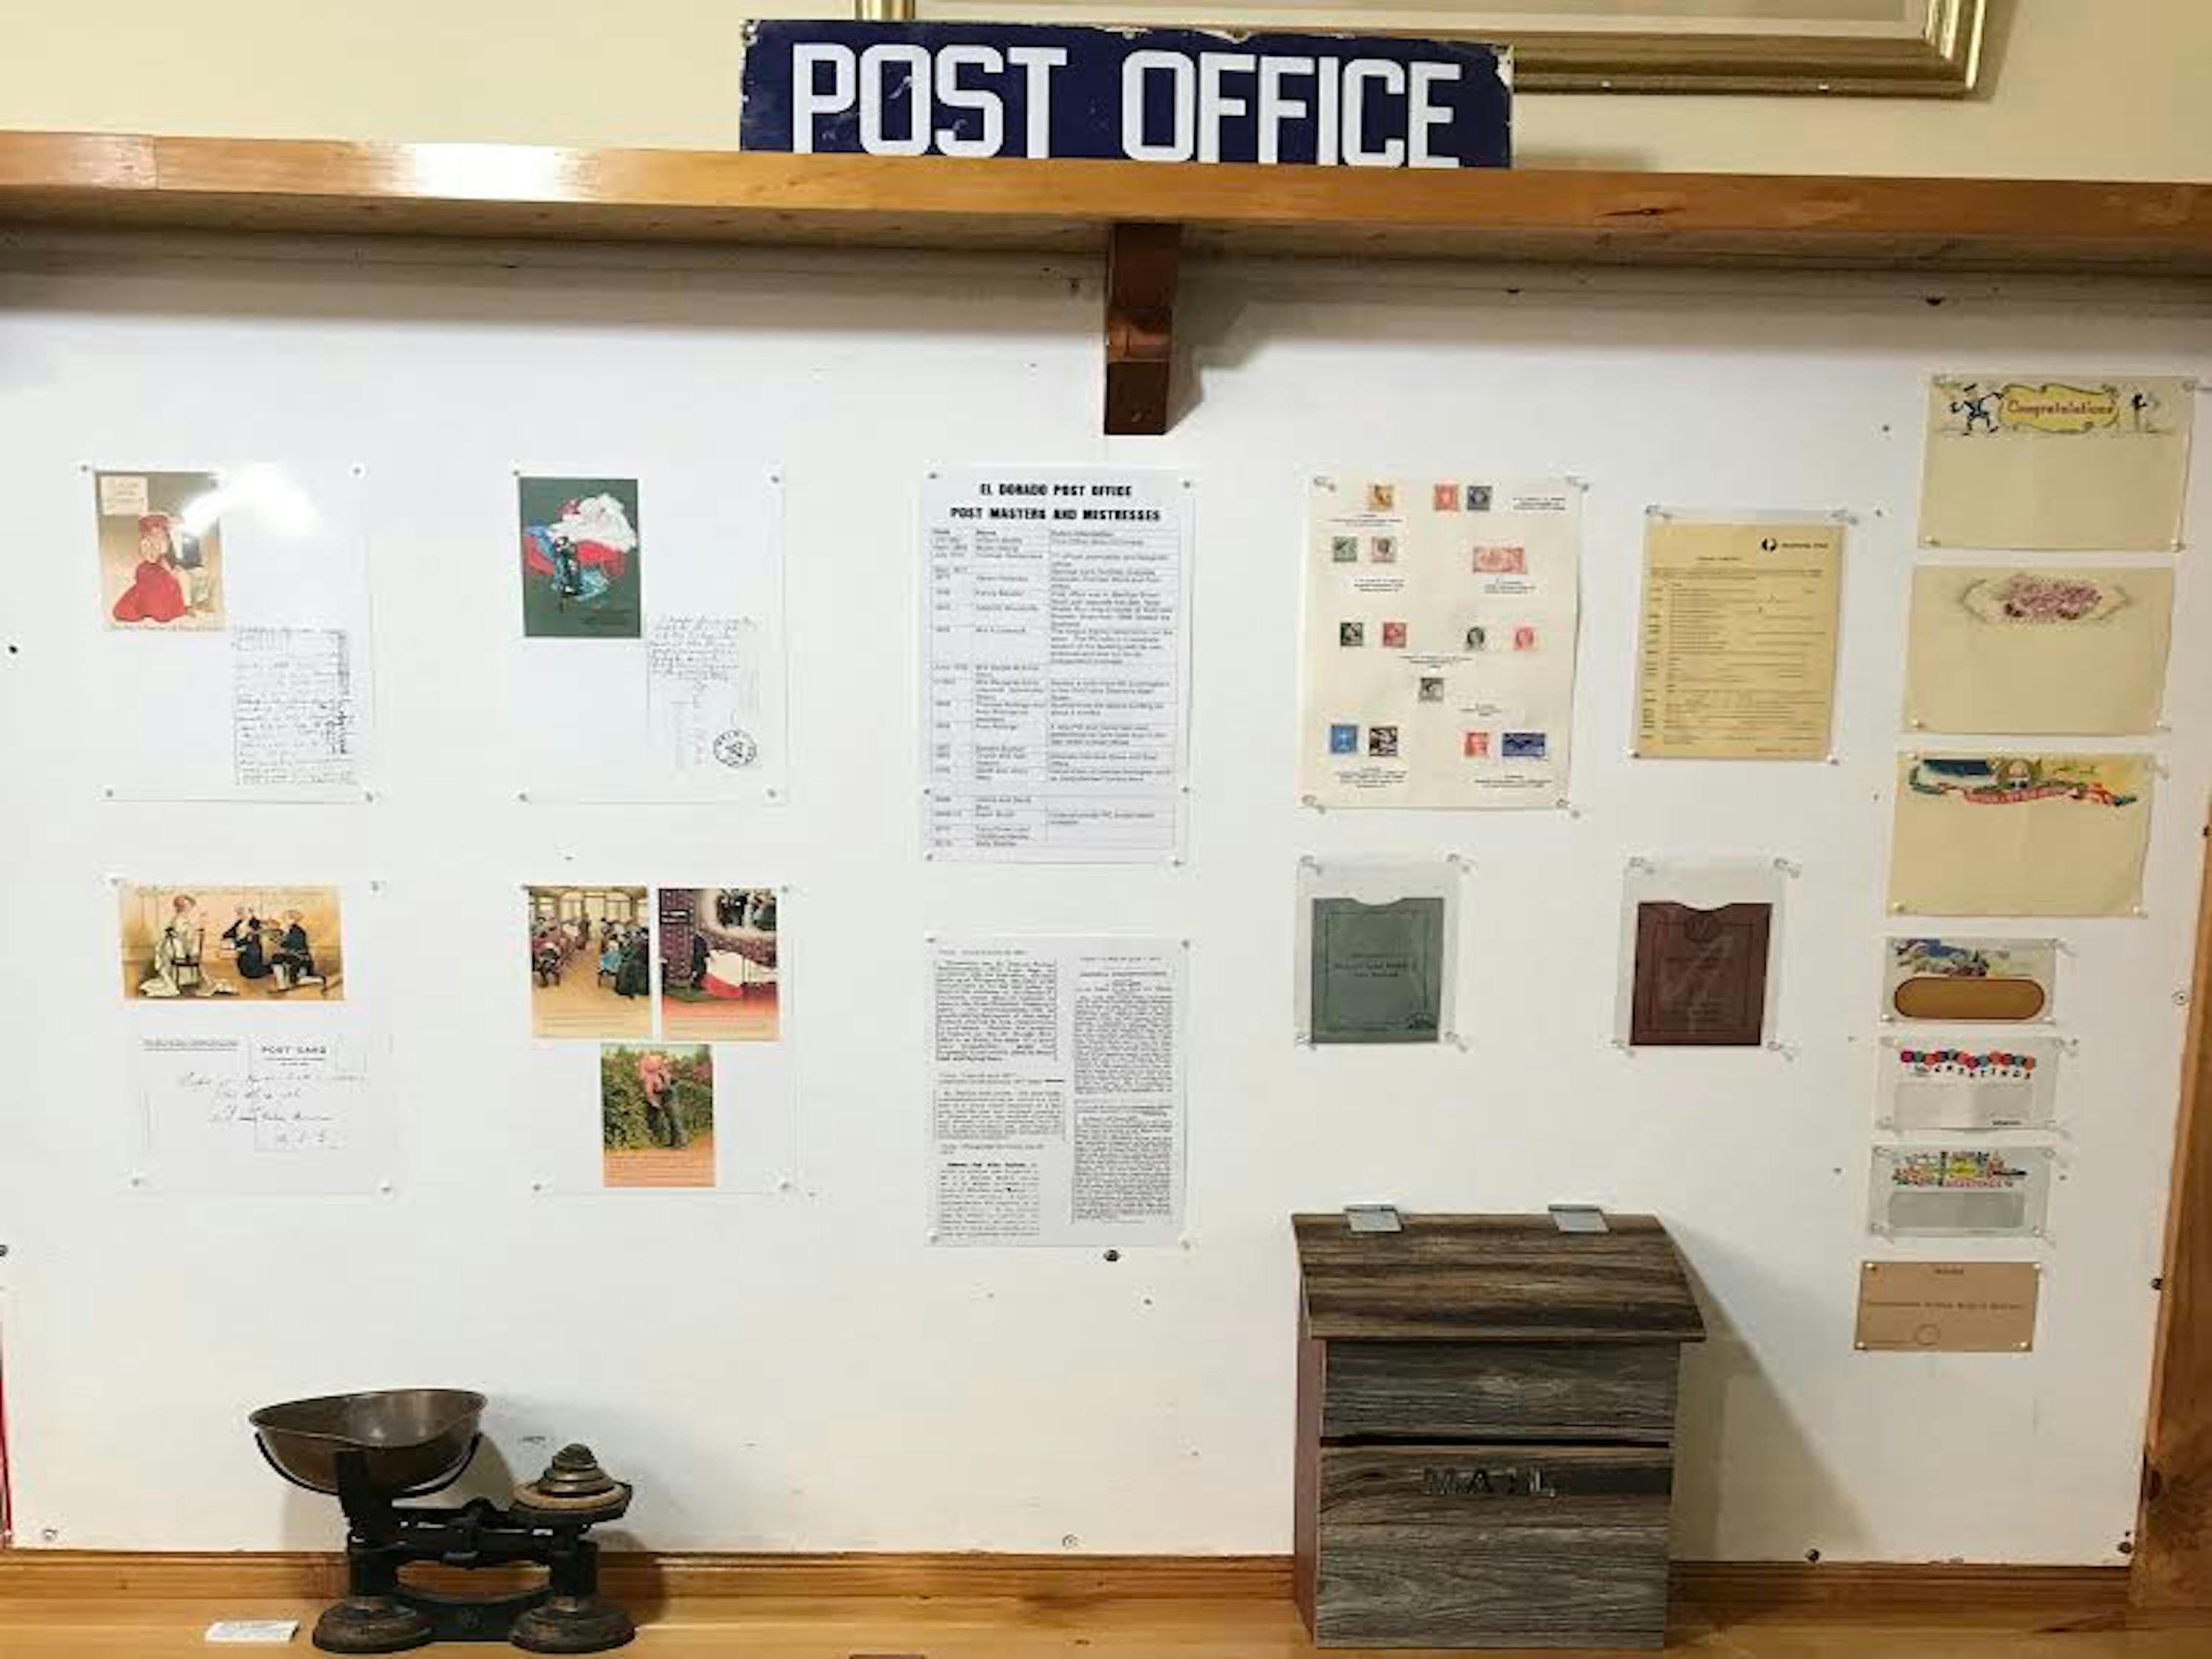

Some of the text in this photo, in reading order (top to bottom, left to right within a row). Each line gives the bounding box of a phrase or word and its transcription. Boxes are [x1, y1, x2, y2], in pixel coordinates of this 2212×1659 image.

[791, 43, 1461, 169] POST OFFICE
[2007, 399, 2114, 418] Congratulations
[979, 483, 1133, 496] EL DORADO POST OFFICE
[951, 507, 1160, 521] POST MASTERS AND MISTRESSES
[1424, 1467, 1556, 1498] MAIL
